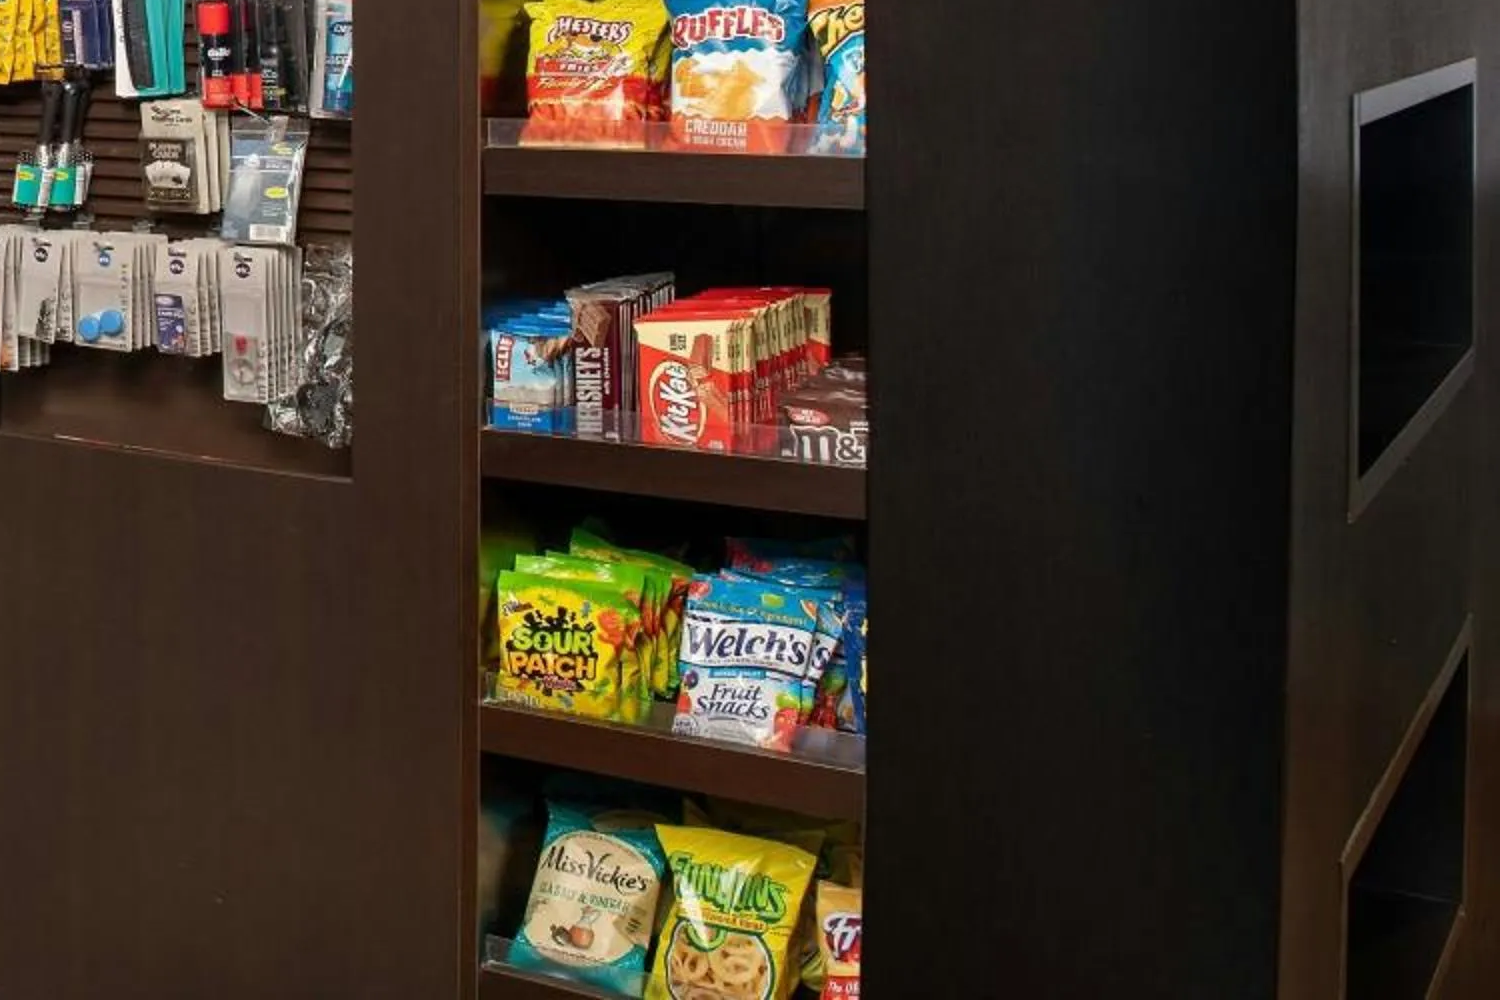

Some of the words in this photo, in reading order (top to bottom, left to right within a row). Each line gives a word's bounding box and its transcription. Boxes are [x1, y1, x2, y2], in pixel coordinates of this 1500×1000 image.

[672, 7, 785, 50] RUFFLES
[512, 625, 594, 657] SOUR
[686, 622, 806, 667] Welch's
[508, 651, 597, 681] PATCH
[696, 695, 770, 721] Snacks
[710, 682, 763, 702] Fruit
[540, 845, 587, 876] Miss
[585, 849, 649, 894] Vickie's
